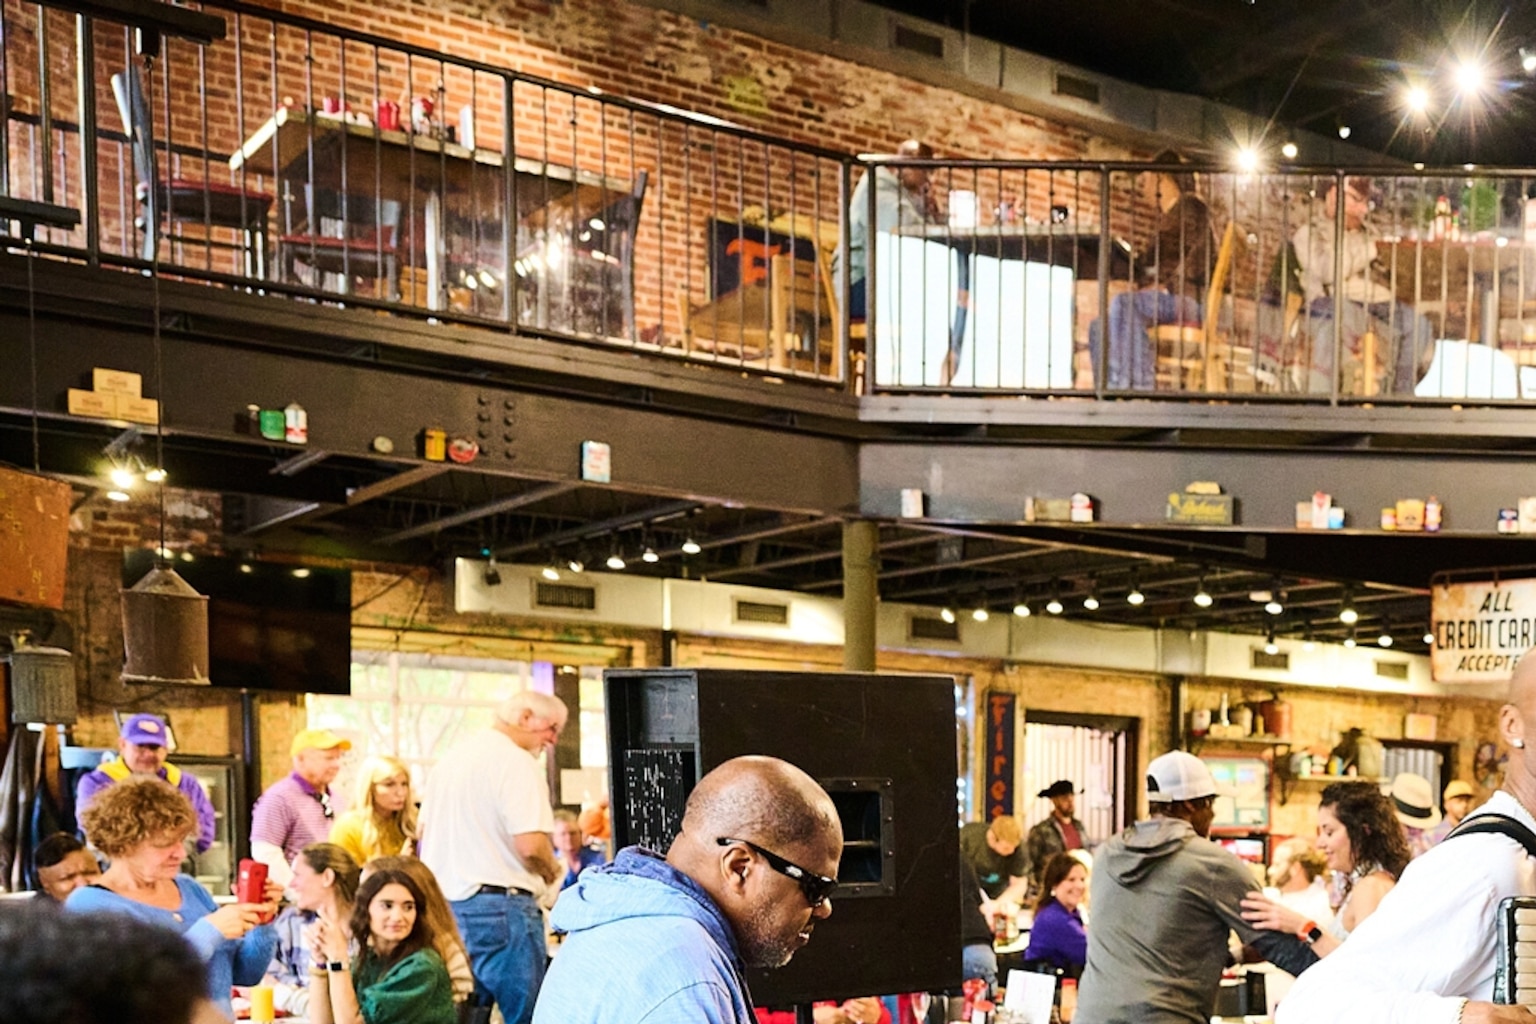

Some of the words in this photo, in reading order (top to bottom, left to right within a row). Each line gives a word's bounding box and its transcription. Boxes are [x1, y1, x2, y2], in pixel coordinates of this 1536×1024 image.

[1480, 592, 1512, 612] ALL
[1437, 620, 1492, 649] CREDIT
[1457, 654, 1521, 672] ACCEPTE
